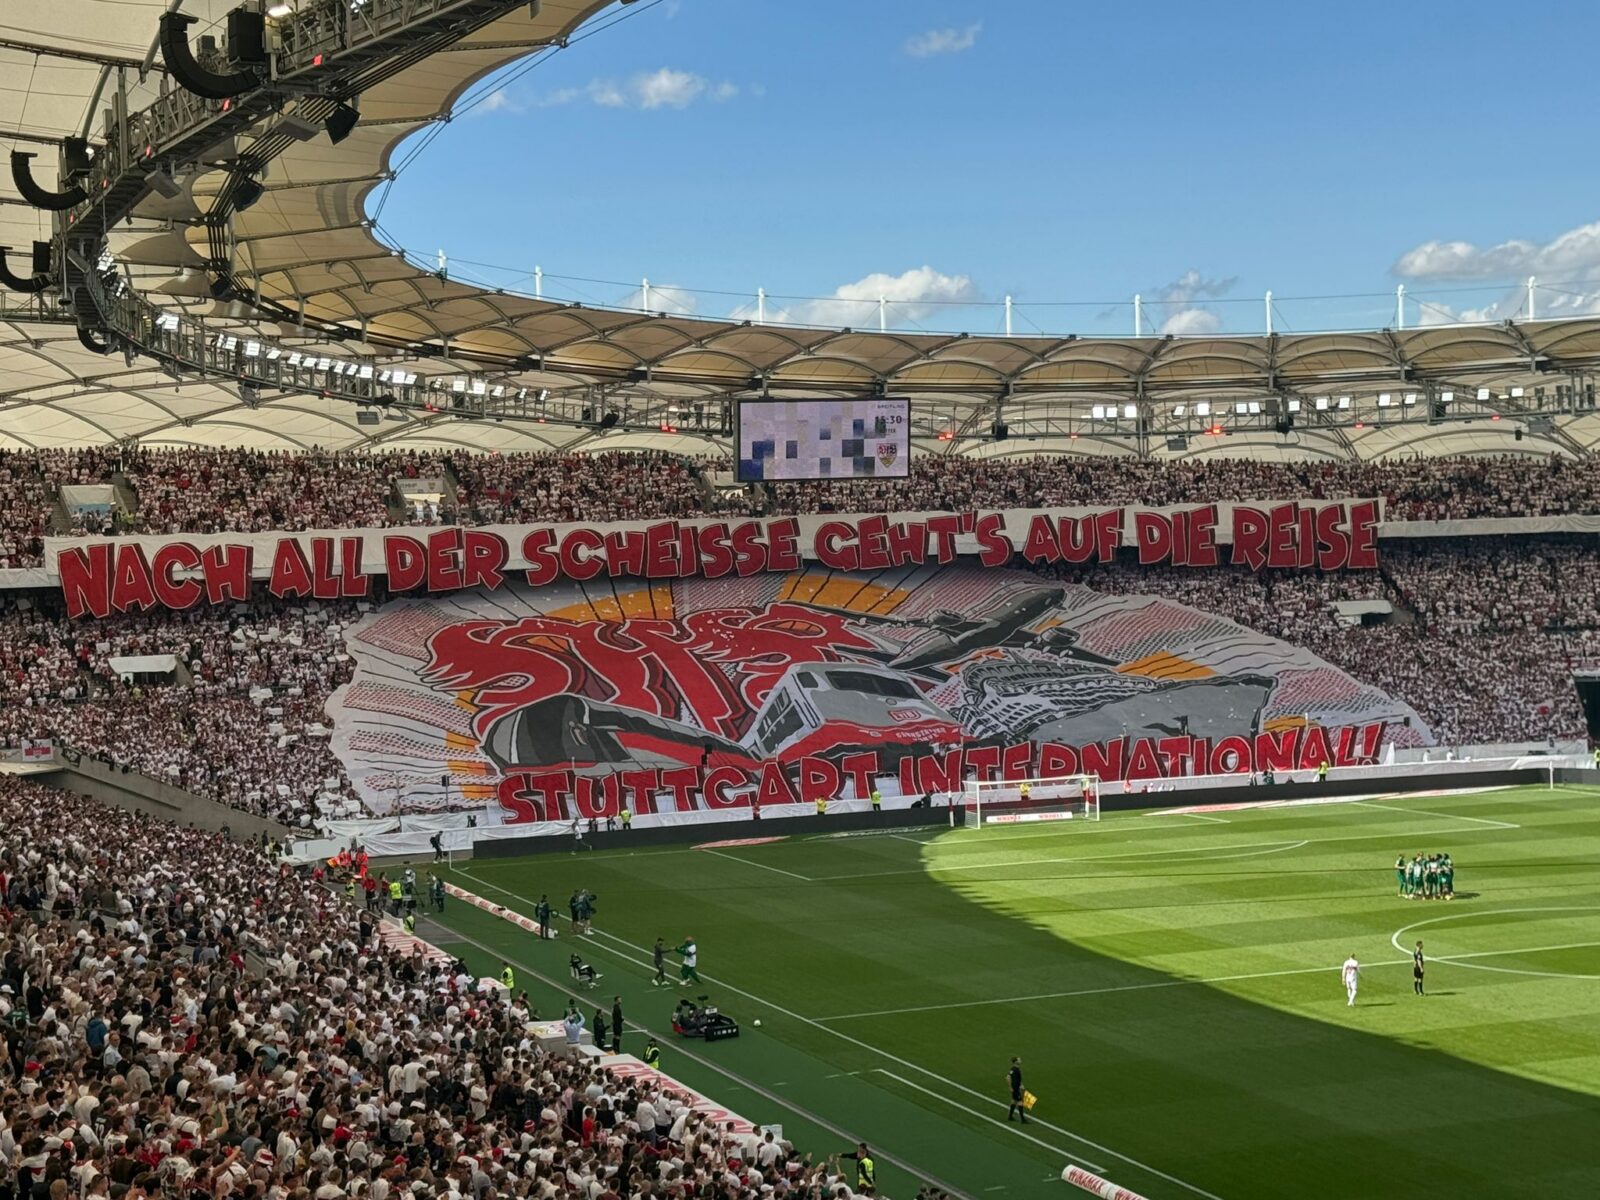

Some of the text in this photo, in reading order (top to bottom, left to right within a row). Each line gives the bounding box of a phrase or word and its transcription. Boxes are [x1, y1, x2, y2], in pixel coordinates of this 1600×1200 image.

[57, 501, 1382, 619] NACH ALL DER SCHEISSE GEHT'S AUF DIE REISE
[500, 721, 1387, 826] STUTTGART INTERNATIONAL!
